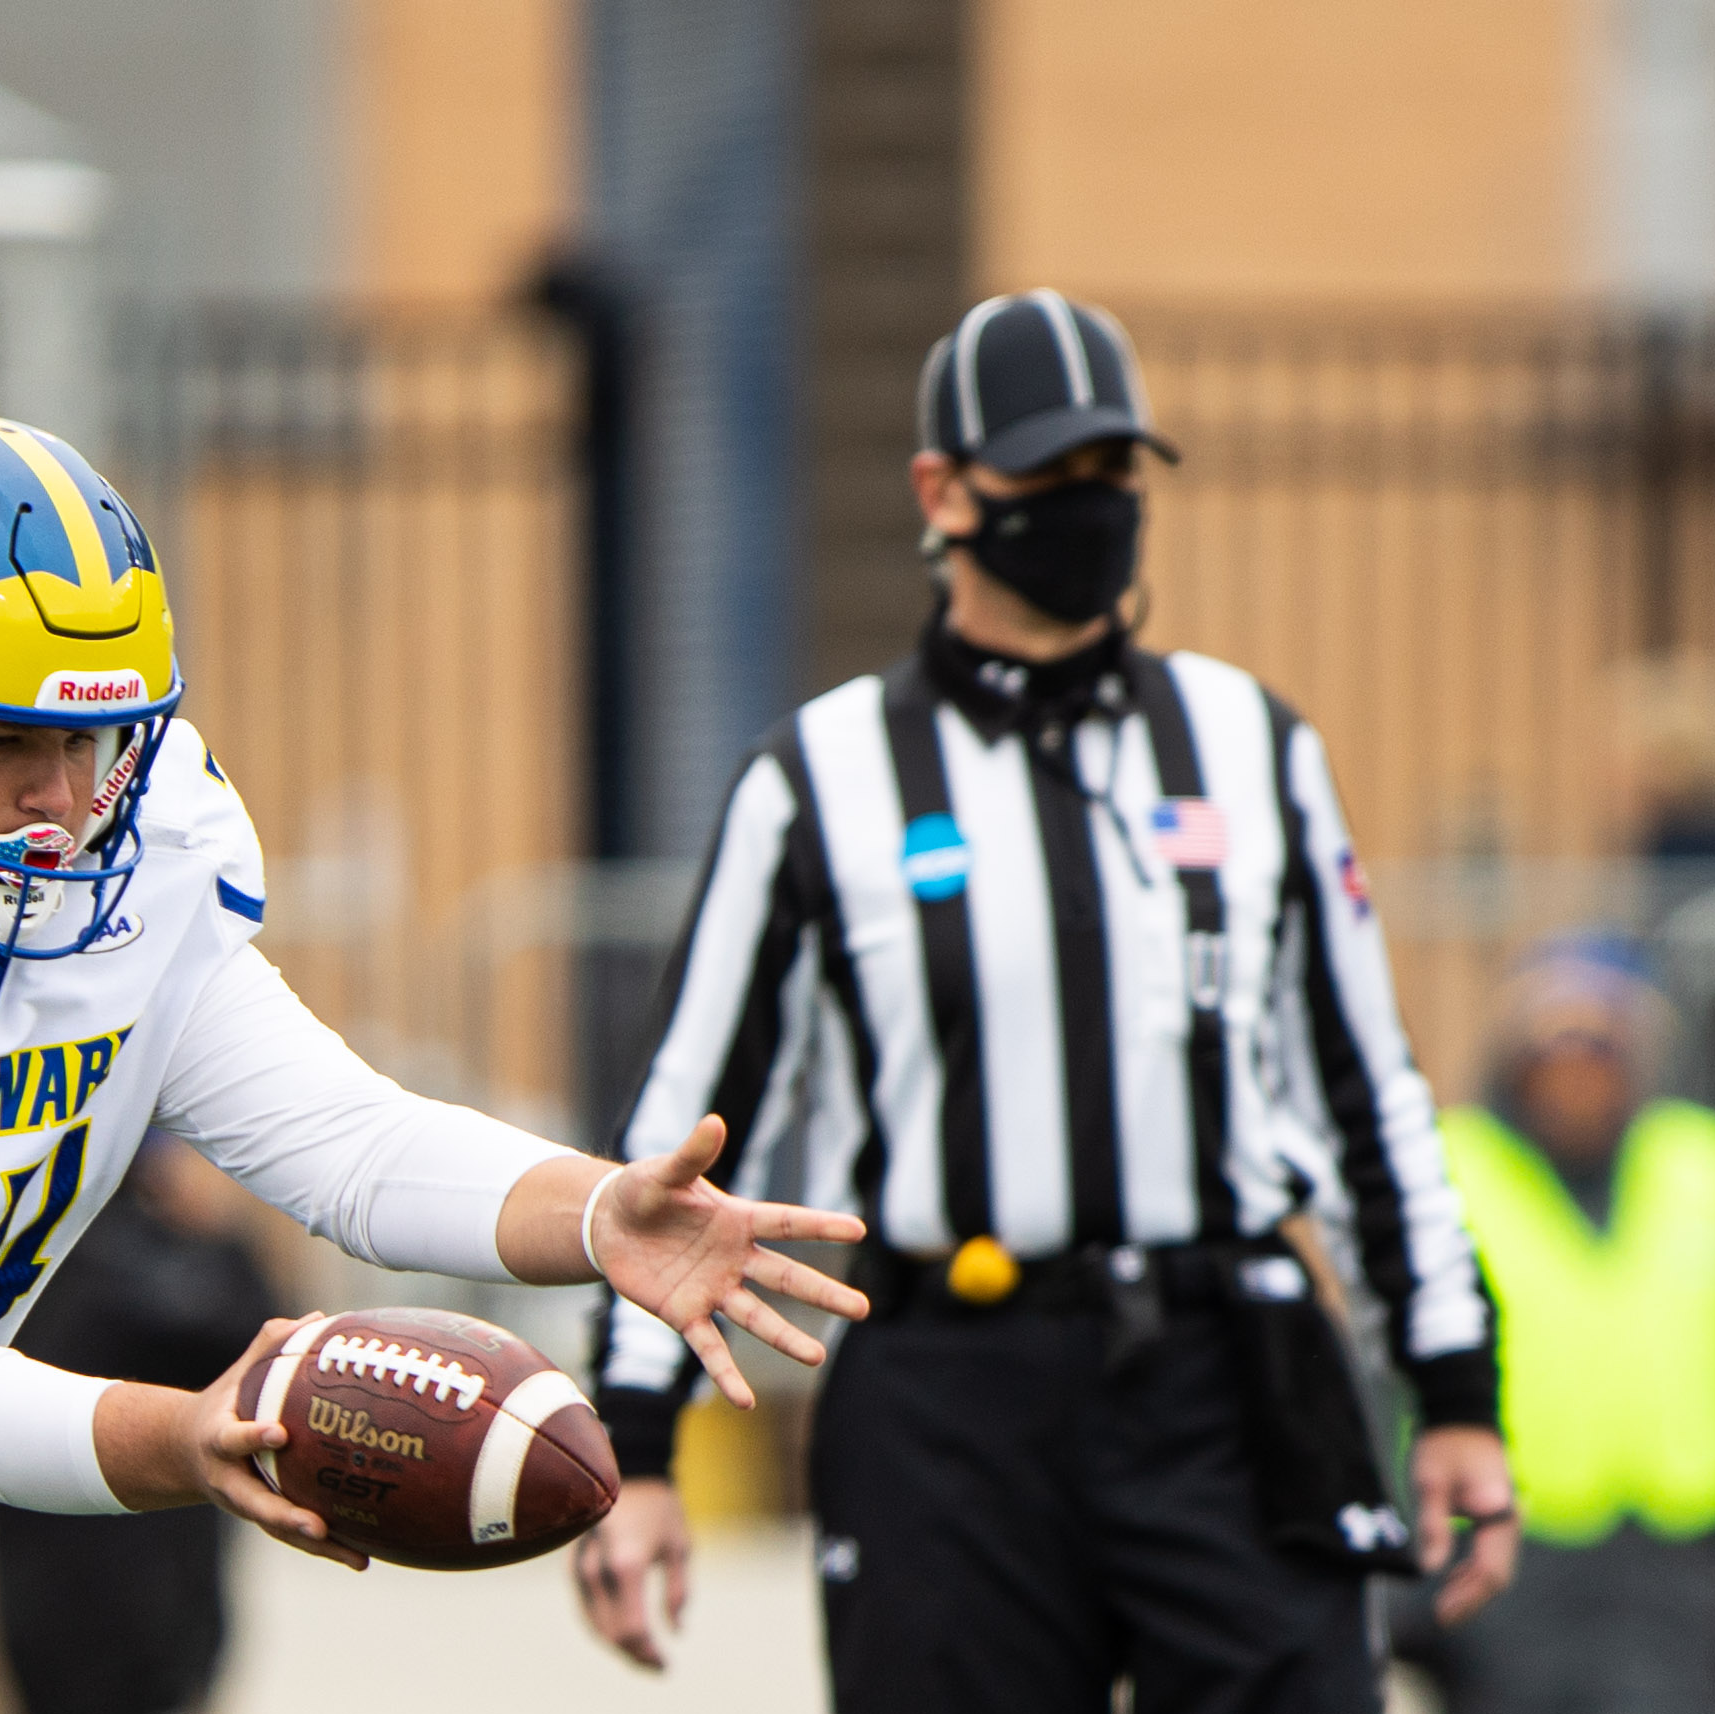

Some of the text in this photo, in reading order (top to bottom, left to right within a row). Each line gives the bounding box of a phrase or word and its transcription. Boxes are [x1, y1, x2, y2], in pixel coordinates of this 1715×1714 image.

[58, 679, 140, 701] Riddell
[308, 1395, 425, 1460] Wilson
[316, 1466, 400, 1503] GST
